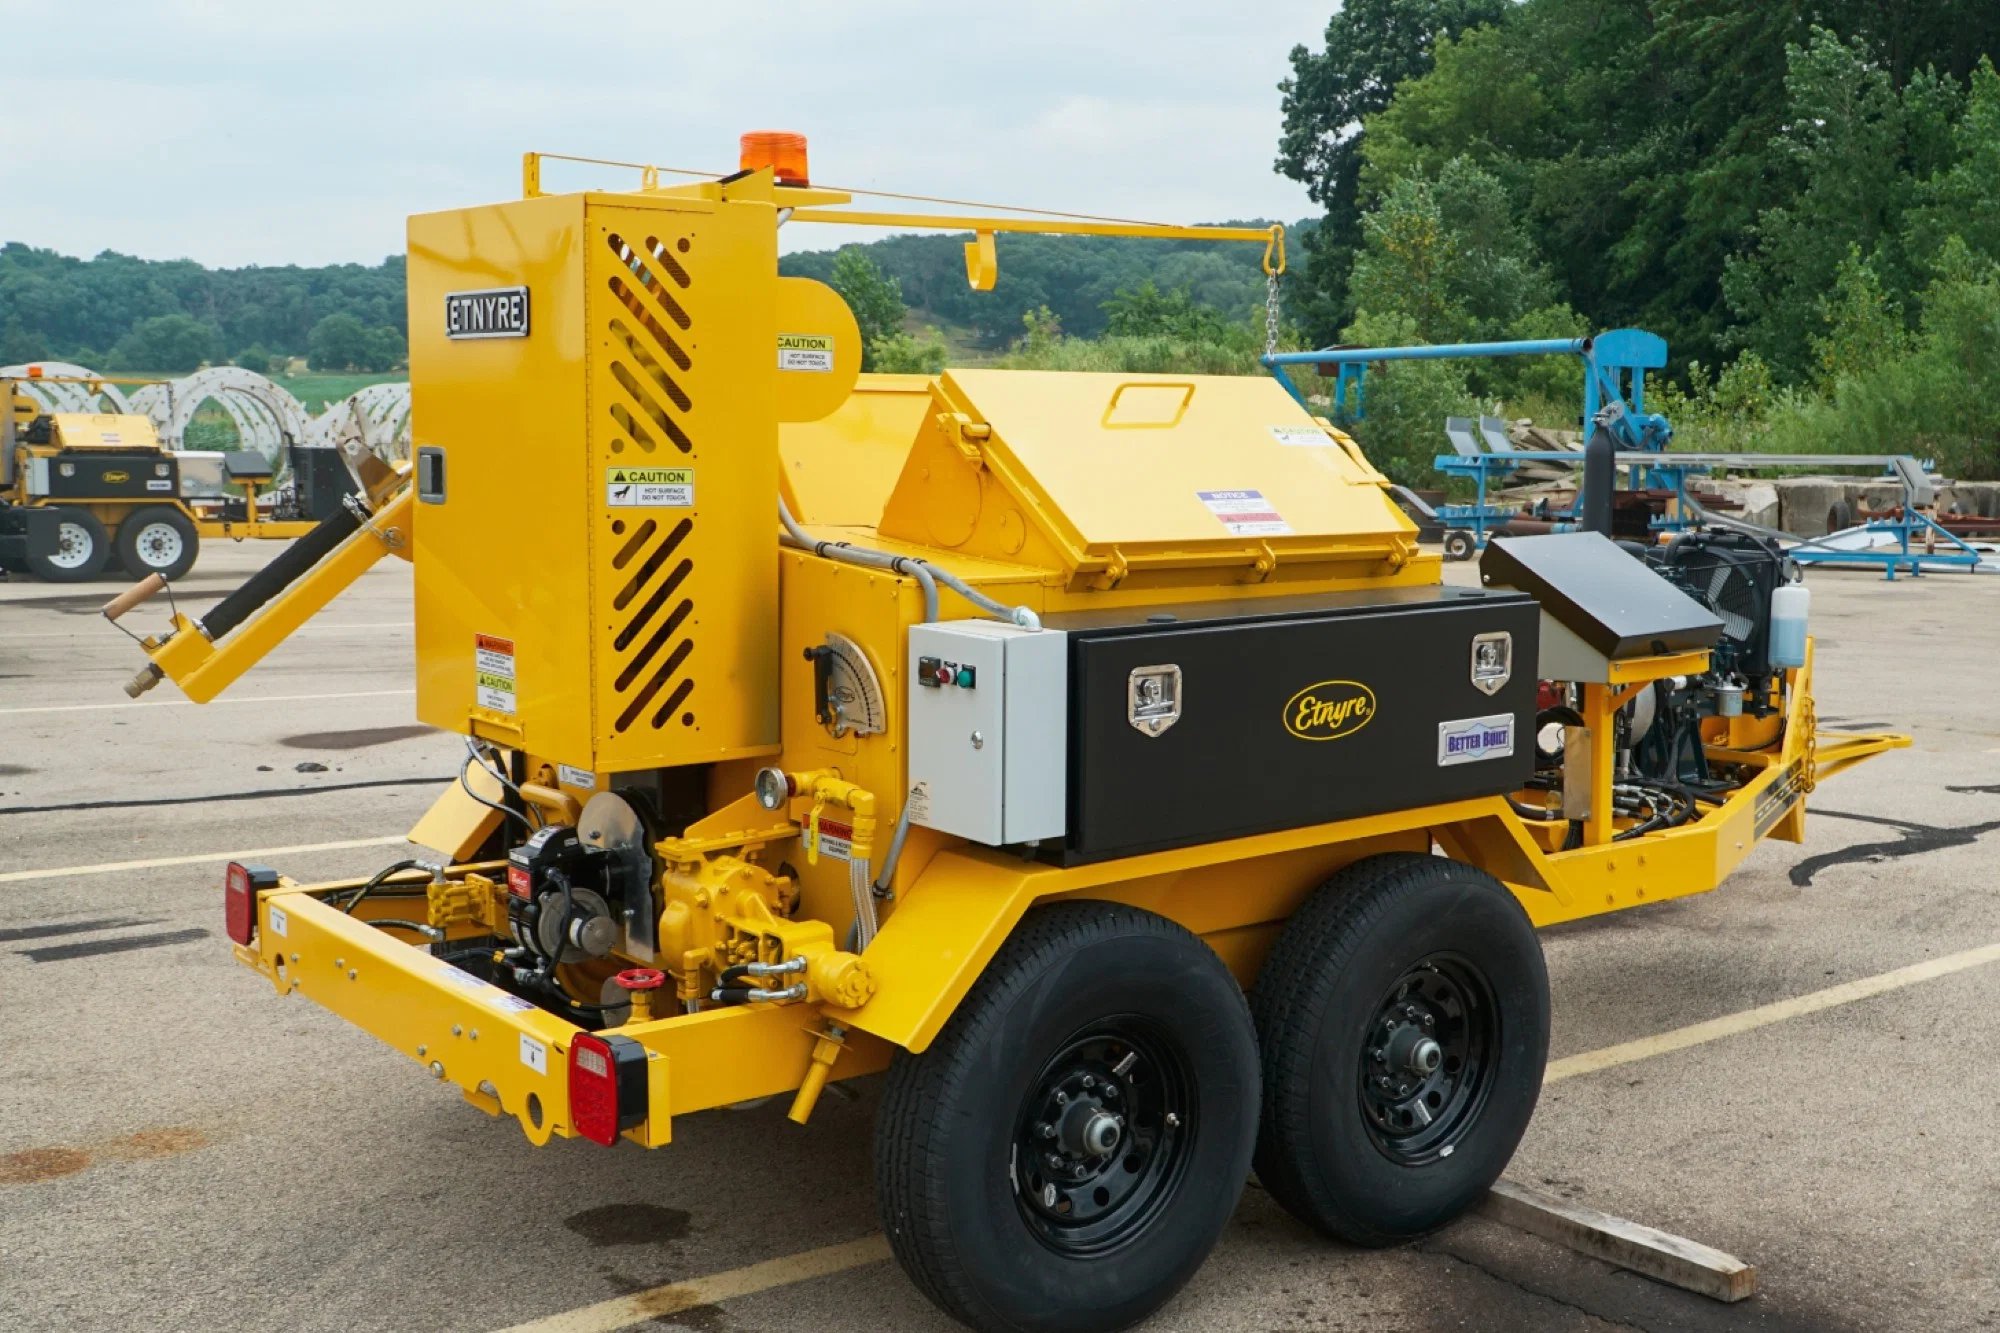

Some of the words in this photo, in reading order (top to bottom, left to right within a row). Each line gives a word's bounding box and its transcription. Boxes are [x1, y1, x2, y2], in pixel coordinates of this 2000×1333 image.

[450, 295, 521, 330] ETNYRE
[629, 471, 686, 483] CAUTION
[485, 676, 513, 691] CAUTION
[1295, 696, 1367, 730] Etnyre
[1447, 734, 1481, 752] BETTER
[1483, 730, 1508, 747] BUILT
